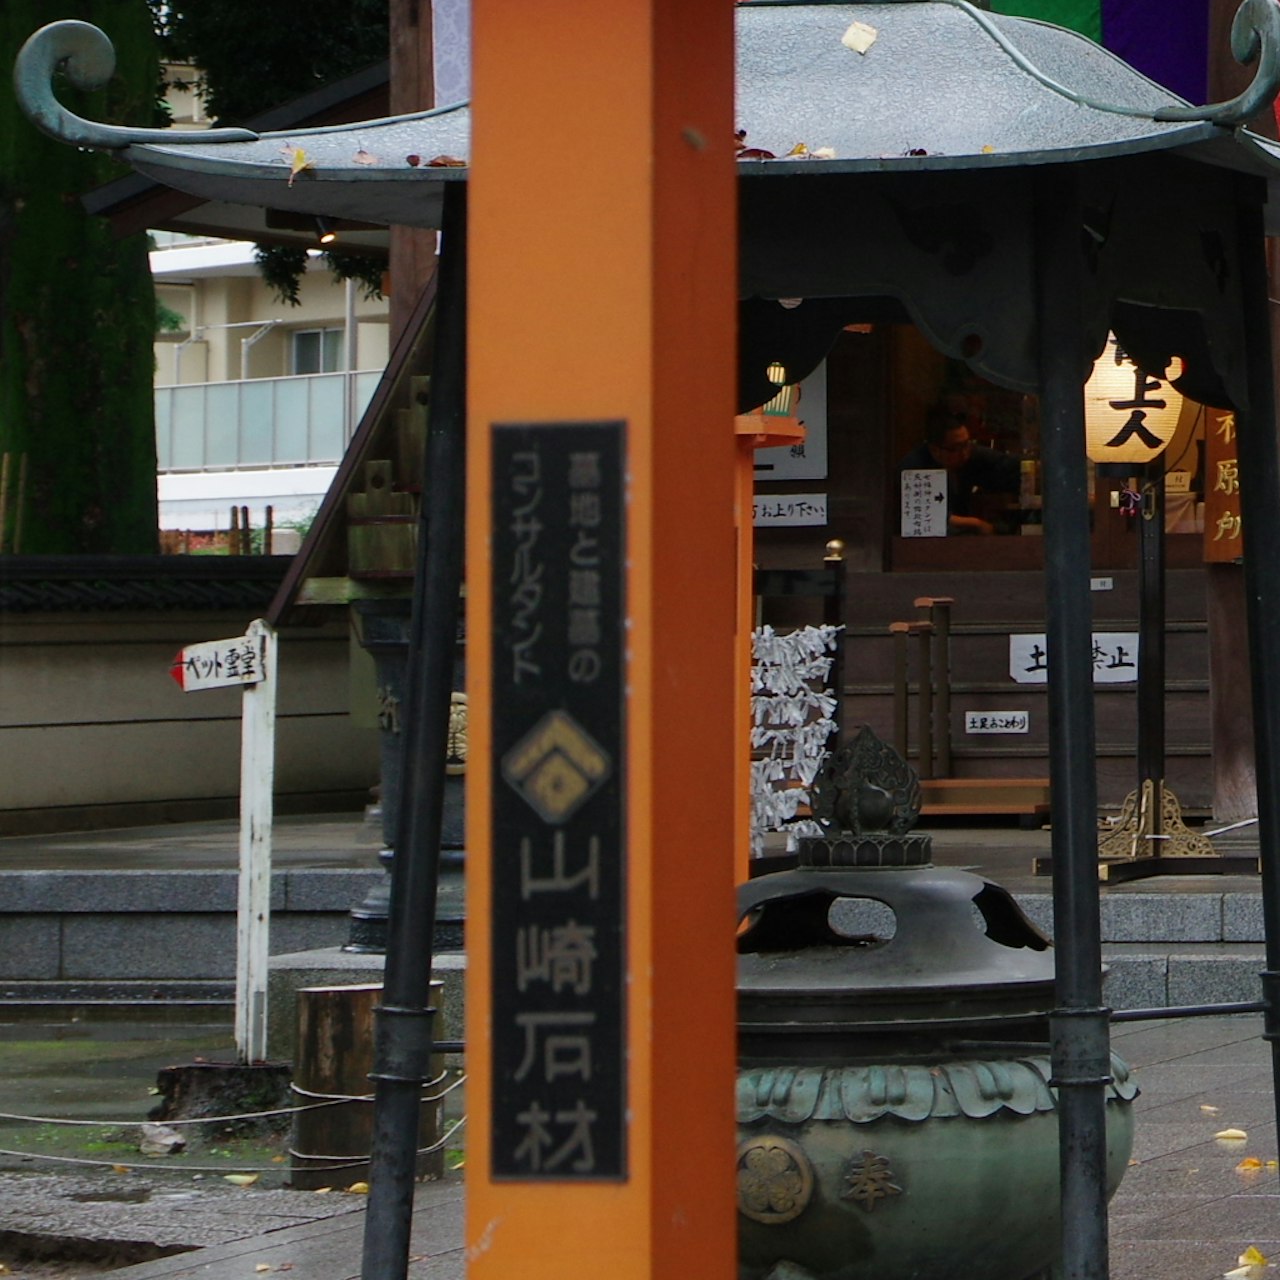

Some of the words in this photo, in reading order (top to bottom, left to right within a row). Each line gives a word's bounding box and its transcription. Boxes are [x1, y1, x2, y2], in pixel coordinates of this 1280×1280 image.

[1105, 342, 1165, 449] 上人
[510, 450, 544, 684] コンサルタント
[1024, 639, 1136, 672] 土止
[513, 829, 601, 1172] 山崎石材
